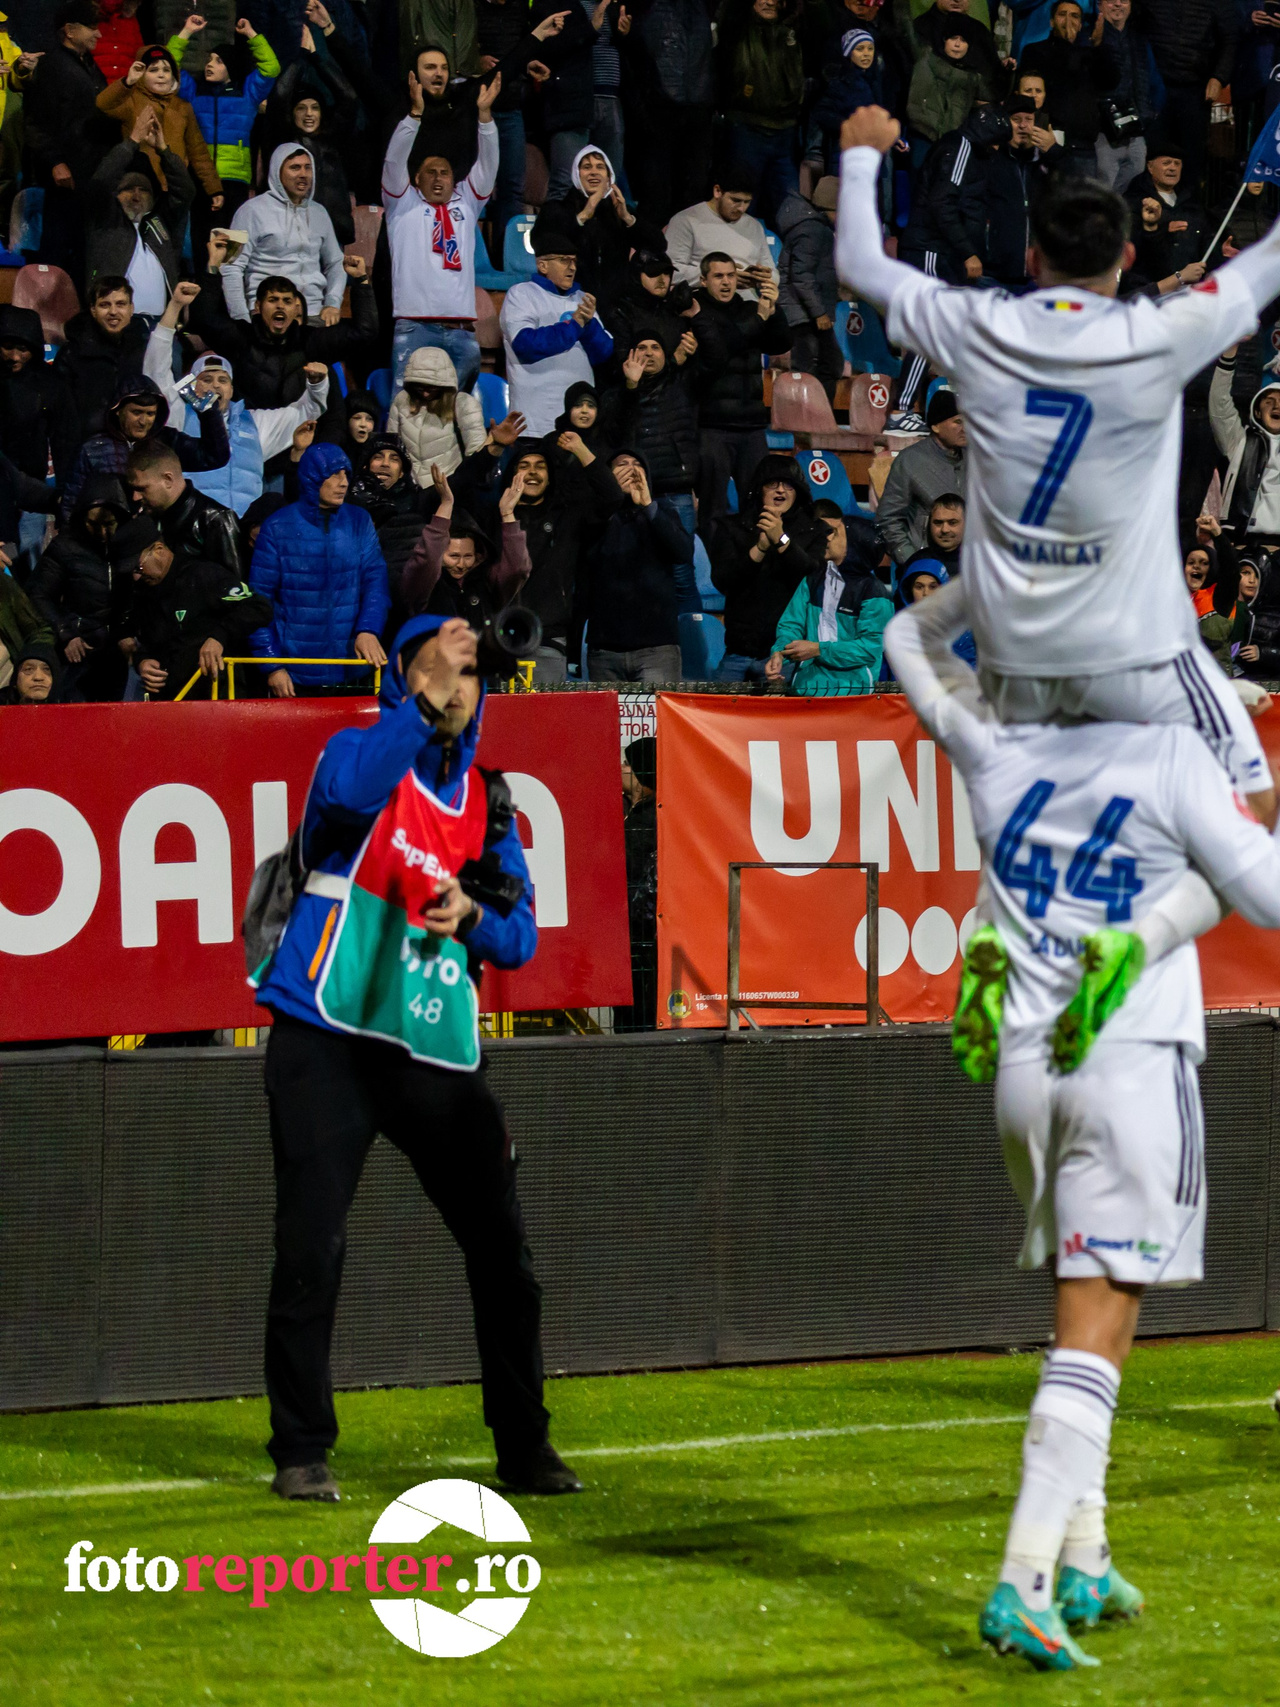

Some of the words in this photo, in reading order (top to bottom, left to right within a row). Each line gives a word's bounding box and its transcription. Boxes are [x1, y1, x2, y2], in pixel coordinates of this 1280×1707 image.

[1019, 389, 1095, 526] 7
[618, 704, 656, 717] BUNA
[994, 779, 1144, 922] 44
[408, 992, 444, 1025] 48
